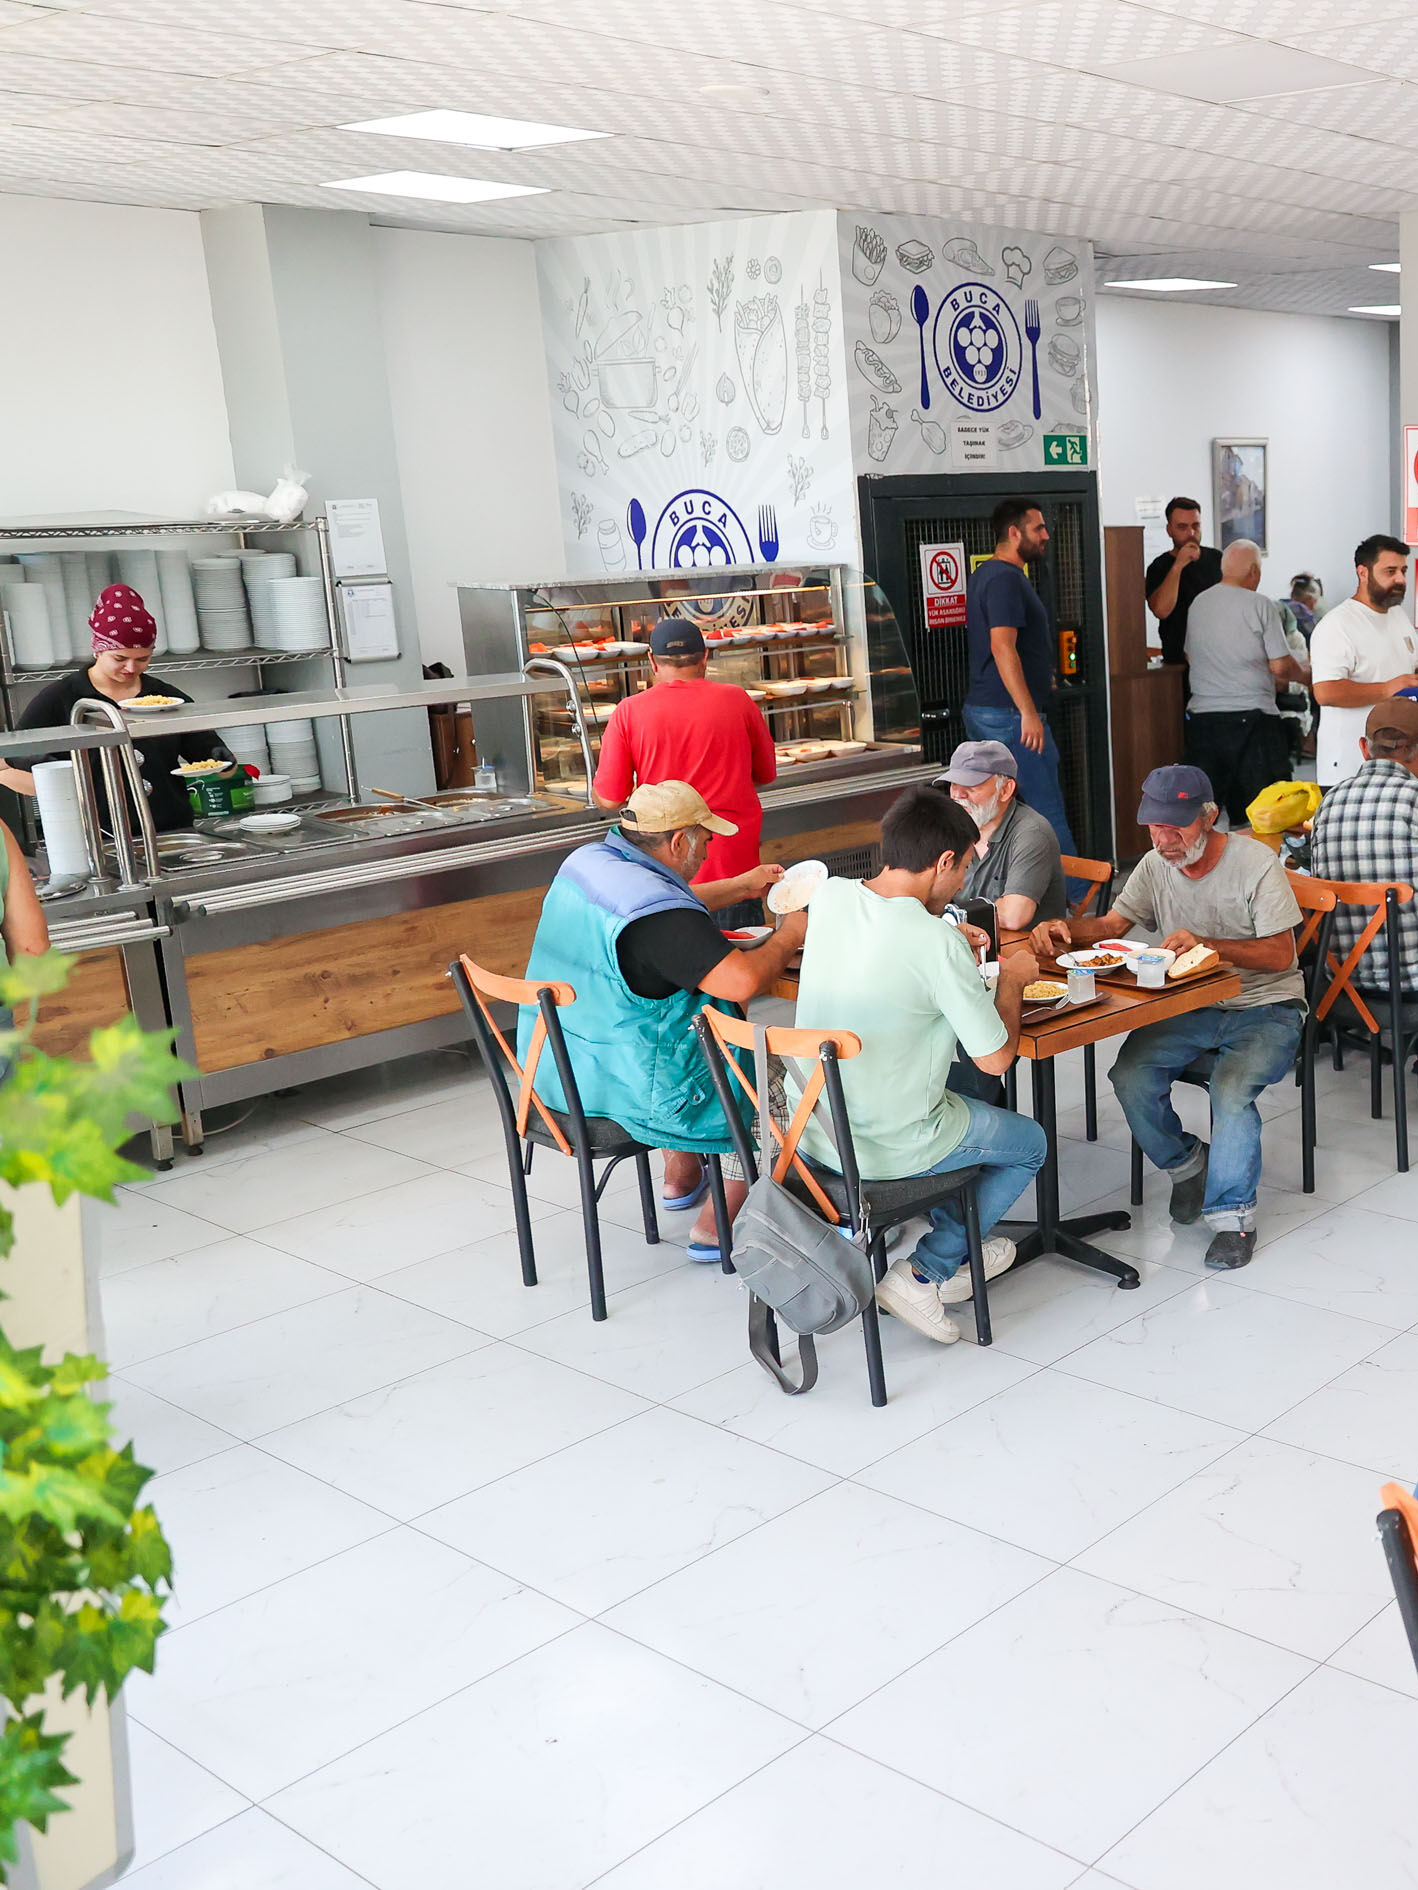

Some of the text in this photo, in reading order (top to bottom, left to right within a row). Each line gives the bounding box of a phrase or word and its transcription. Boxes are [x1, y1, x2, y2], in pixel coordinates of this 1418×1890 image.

[950, 290, 1001, 316] BUCA
[943, 366, 1017, 407] BELEDİYESİ
[669, 499, 727, 529] BUCA
[934, 596, 958, 606] DİKKAT
